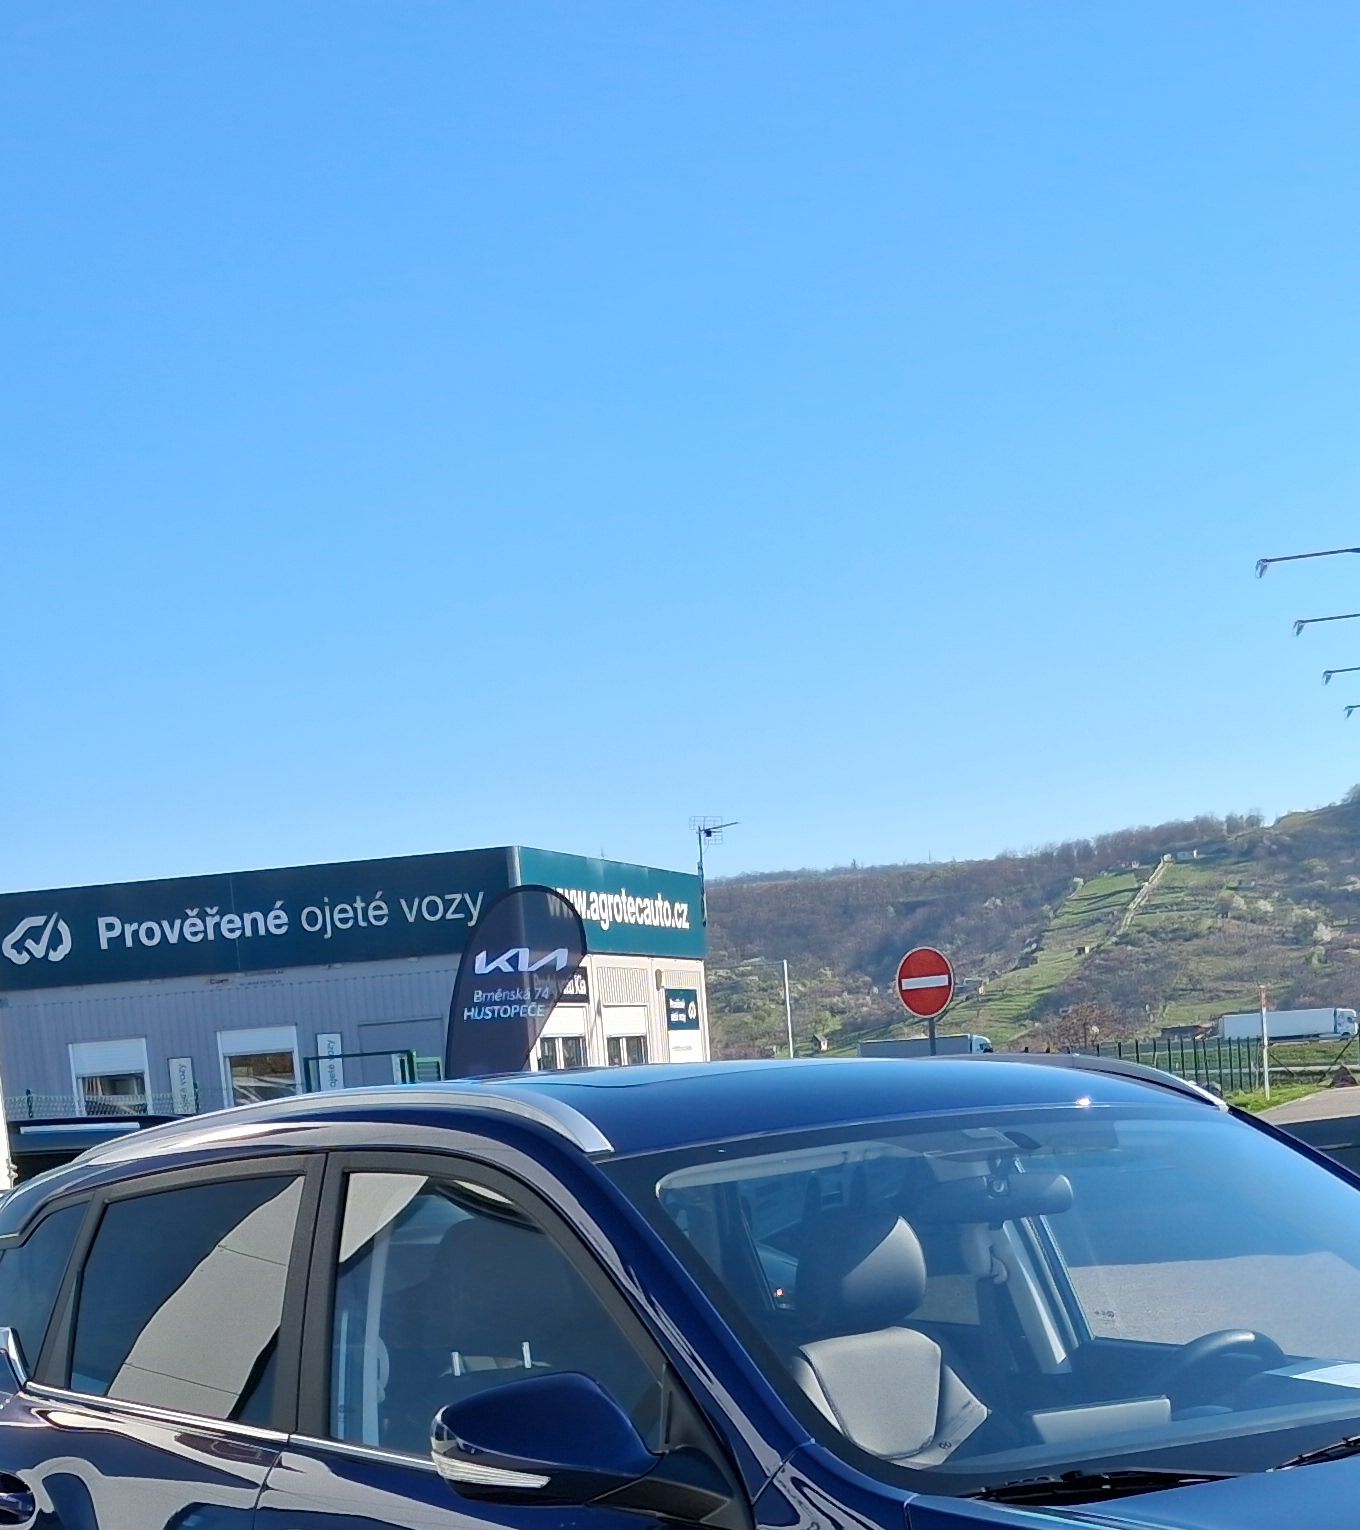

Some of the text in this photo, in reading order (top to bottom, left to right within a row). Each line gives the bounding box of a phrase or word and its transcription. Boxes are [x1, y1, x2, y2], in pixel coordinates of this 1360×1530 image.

[97, 890, 485, 950] Prověřené ojeté vozy
[474, 947, 569, 975] KIA
[534, 987, 549, 1000] 74
